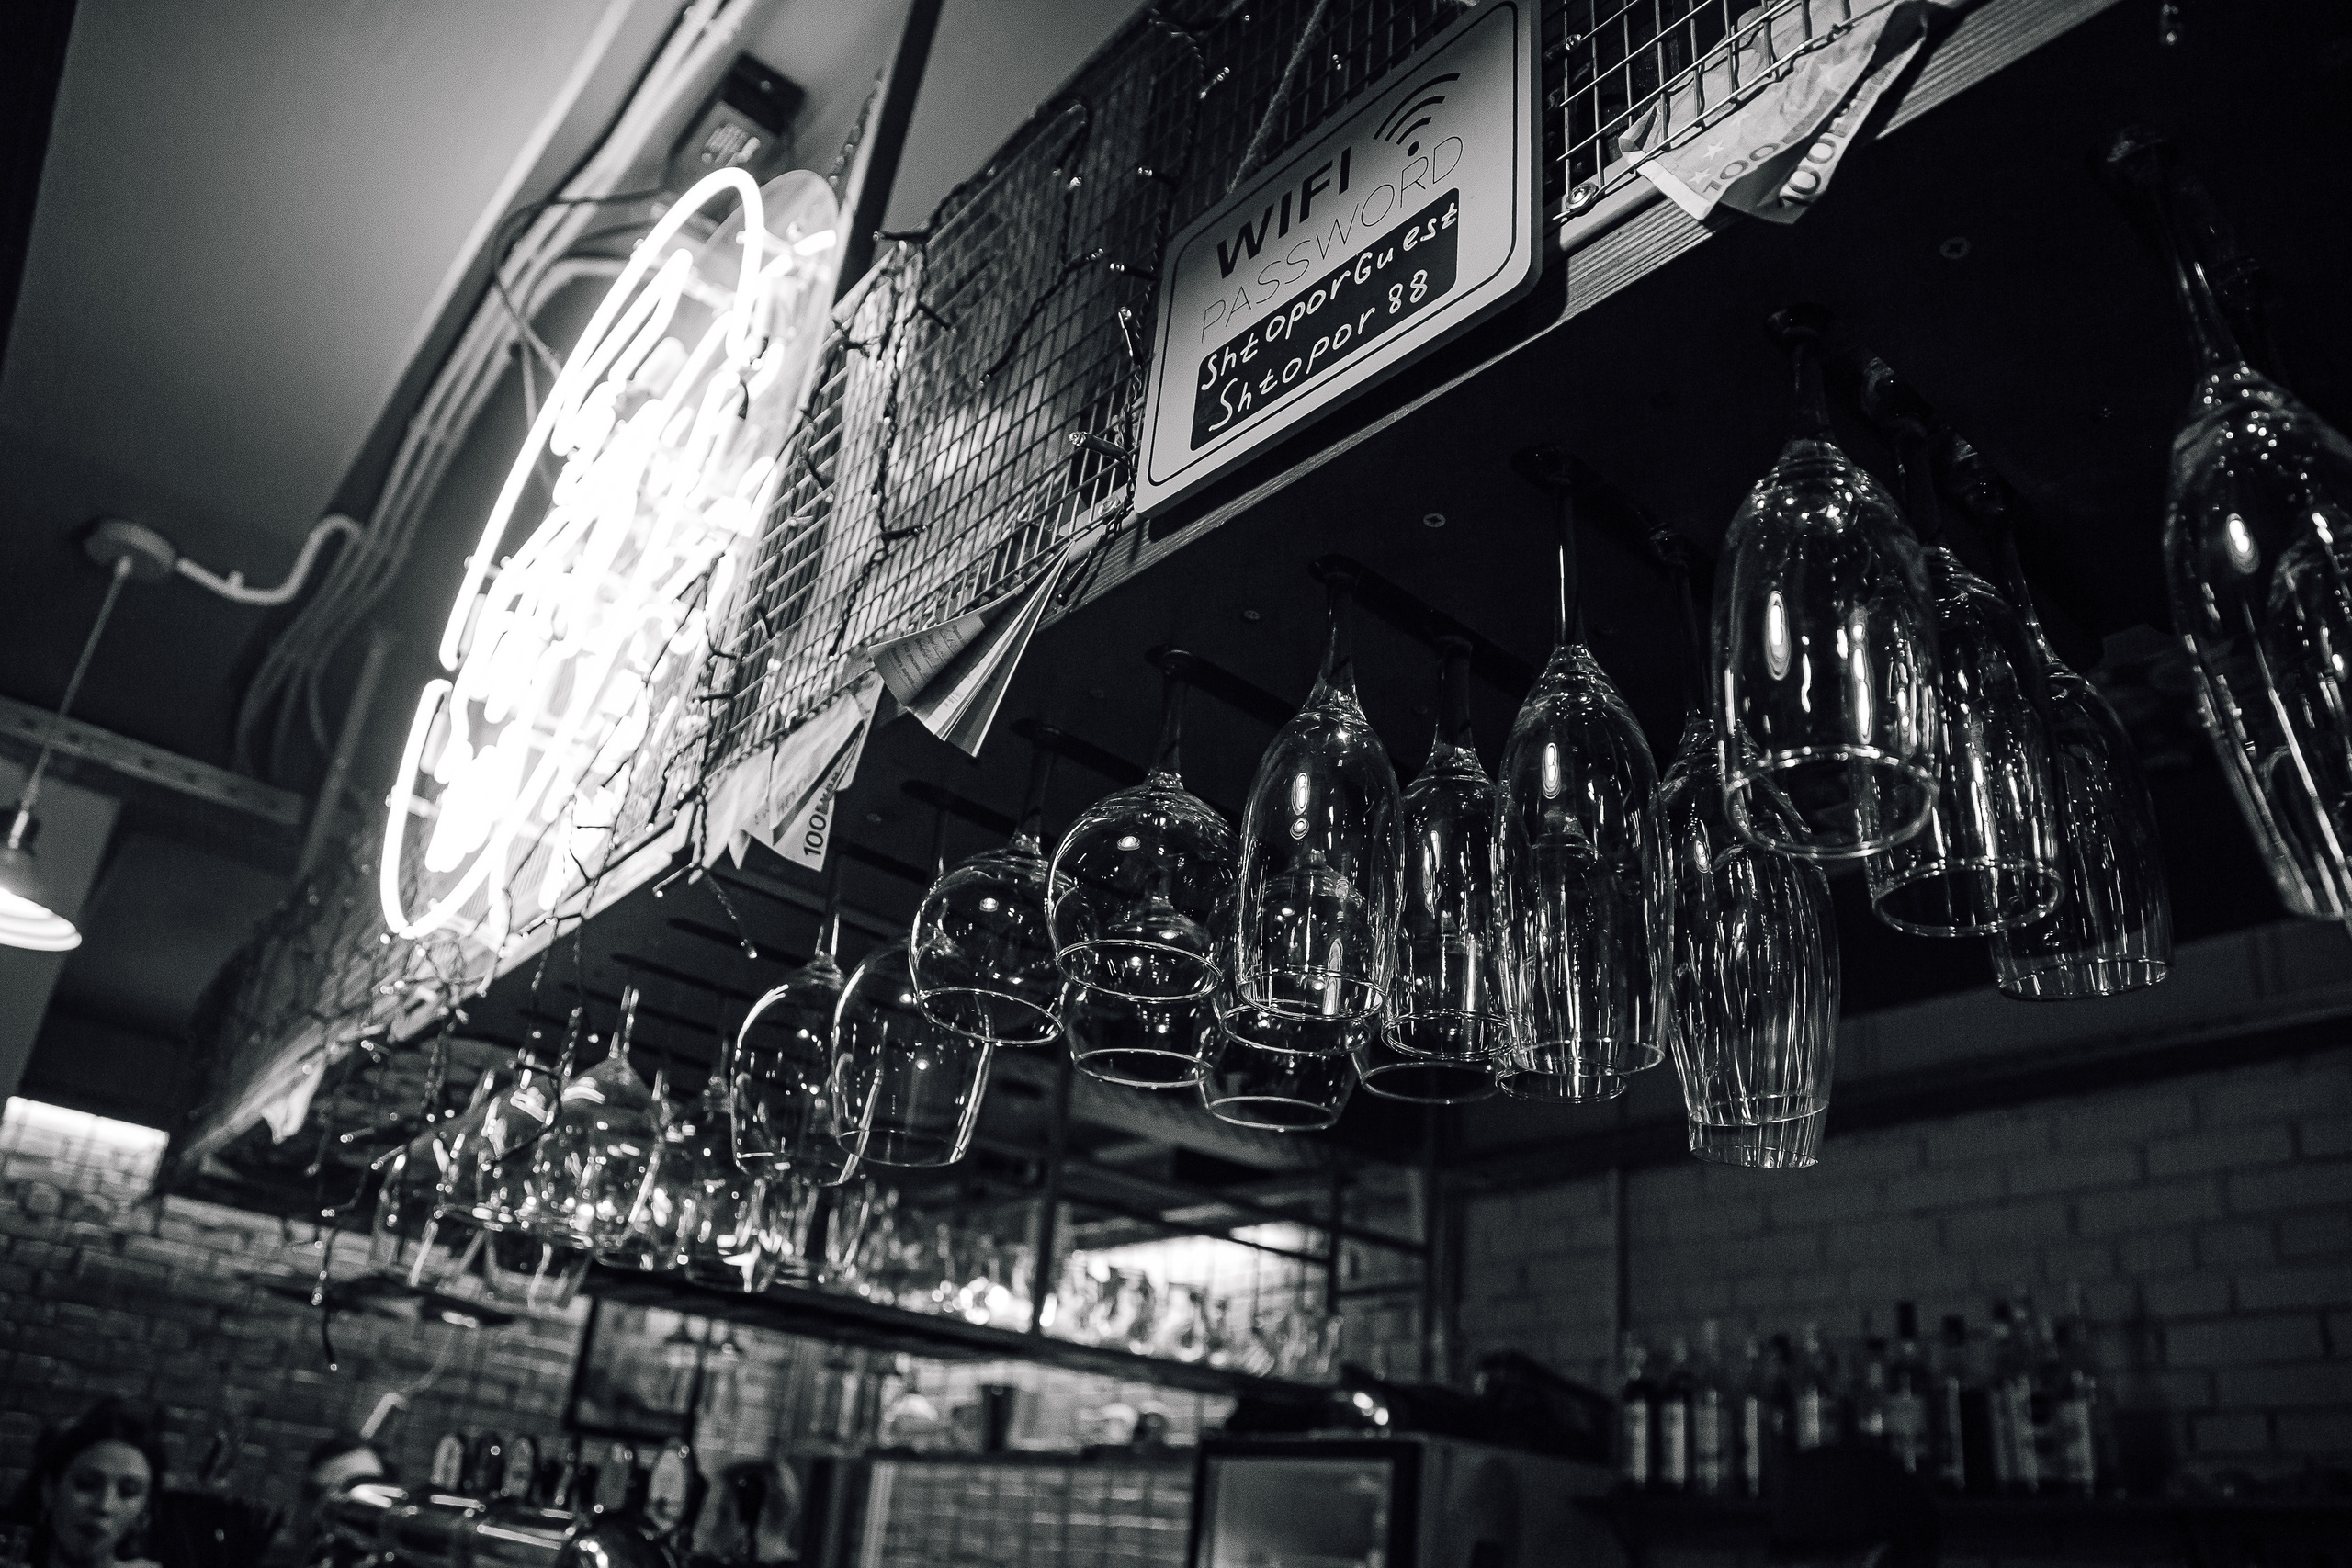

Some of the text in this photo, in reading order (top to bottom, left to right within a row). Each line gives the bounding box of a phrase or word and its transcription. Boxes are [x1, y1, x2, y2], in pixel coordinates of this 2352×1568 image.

[1201, 136, 1464, 343] PASSWORD
[1217, 147, 1351, 278] WIFI
[804, 814, 826, 855] 100
